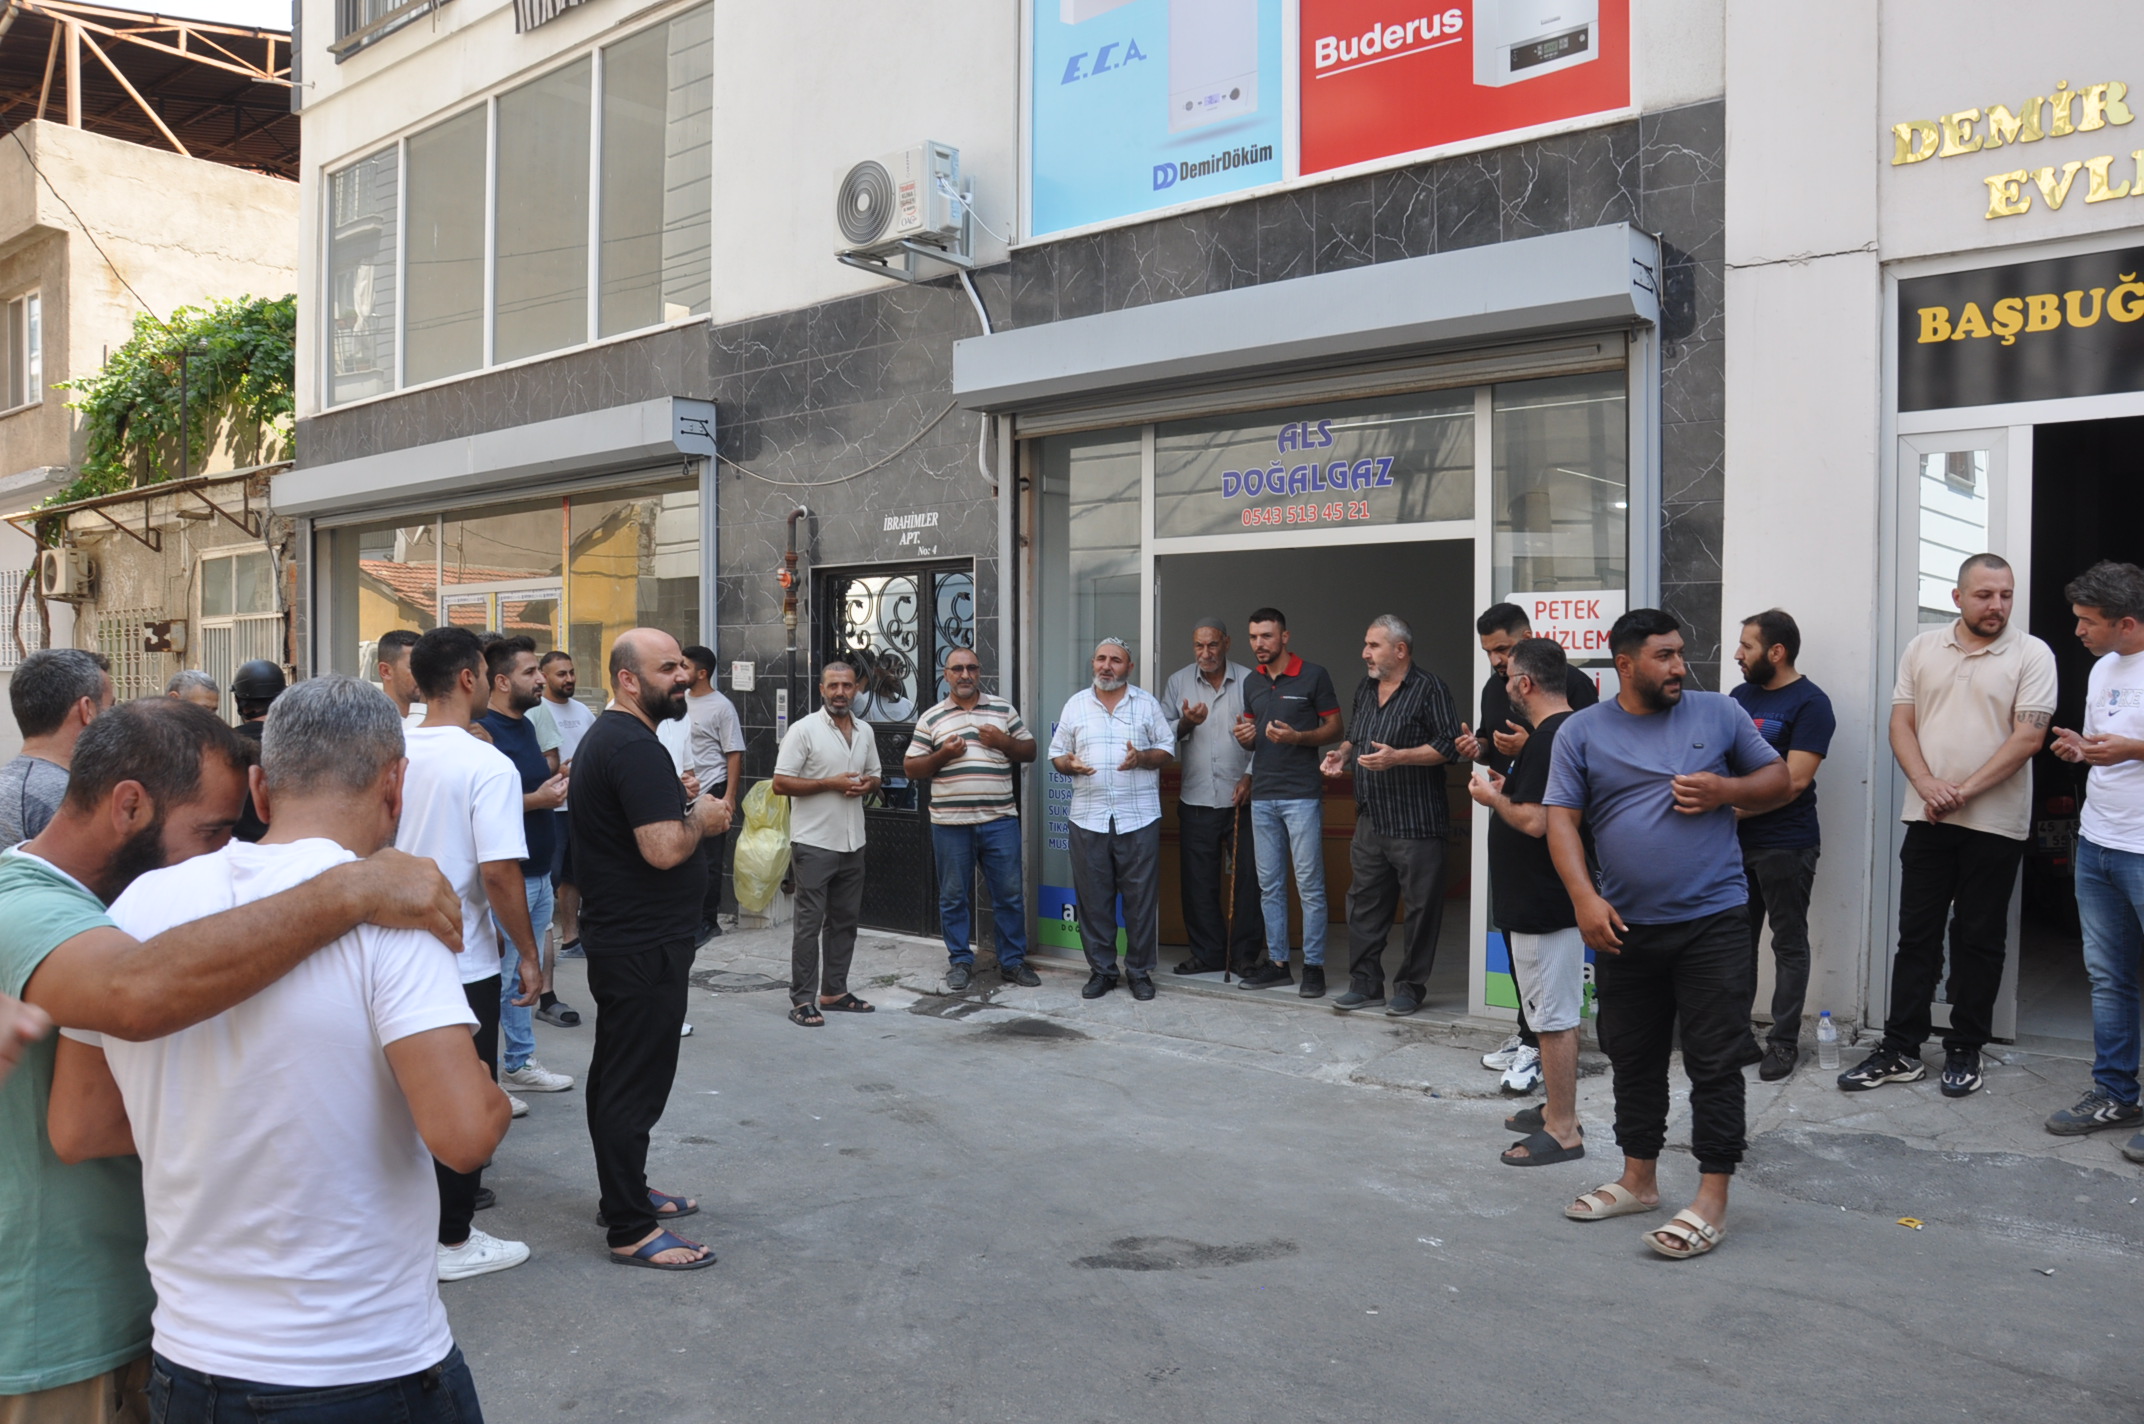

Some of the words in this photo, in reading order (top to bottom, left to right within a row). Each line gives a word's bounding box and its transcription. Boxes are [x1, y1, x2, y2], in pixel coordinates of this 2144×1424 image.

[1315, 8, 1463, 69] Buderus
[1891, 80, 2134, 166] DEMİR
[1180, 144, 1273, 181] DemirDöküm
[1917, 271, 2144, 346] BAŞBUĞ
[1277, 419, 1334, 456] ALS
[1221, 456, 1395, 499] DOĞALGAZ
[883, 510, 939, 531] İBRAHİMLER
[1242, 507, 1283, 527] 0543
[1286, 504, 1319, 524] 513
[1322, 501, 1344, 521] 45
[1348, 500, 1370, 519] 21
[899, 531, 921, 546] APT.
[1535, 599, 1600, 620] PETEK
[1532, 625, 1612, 650] MİZLEM
[1048, 788, 1073, 802] DUŞA
[1062, 806, 1068, 816] K
[1048, 821, 1069, 833] TIKA
